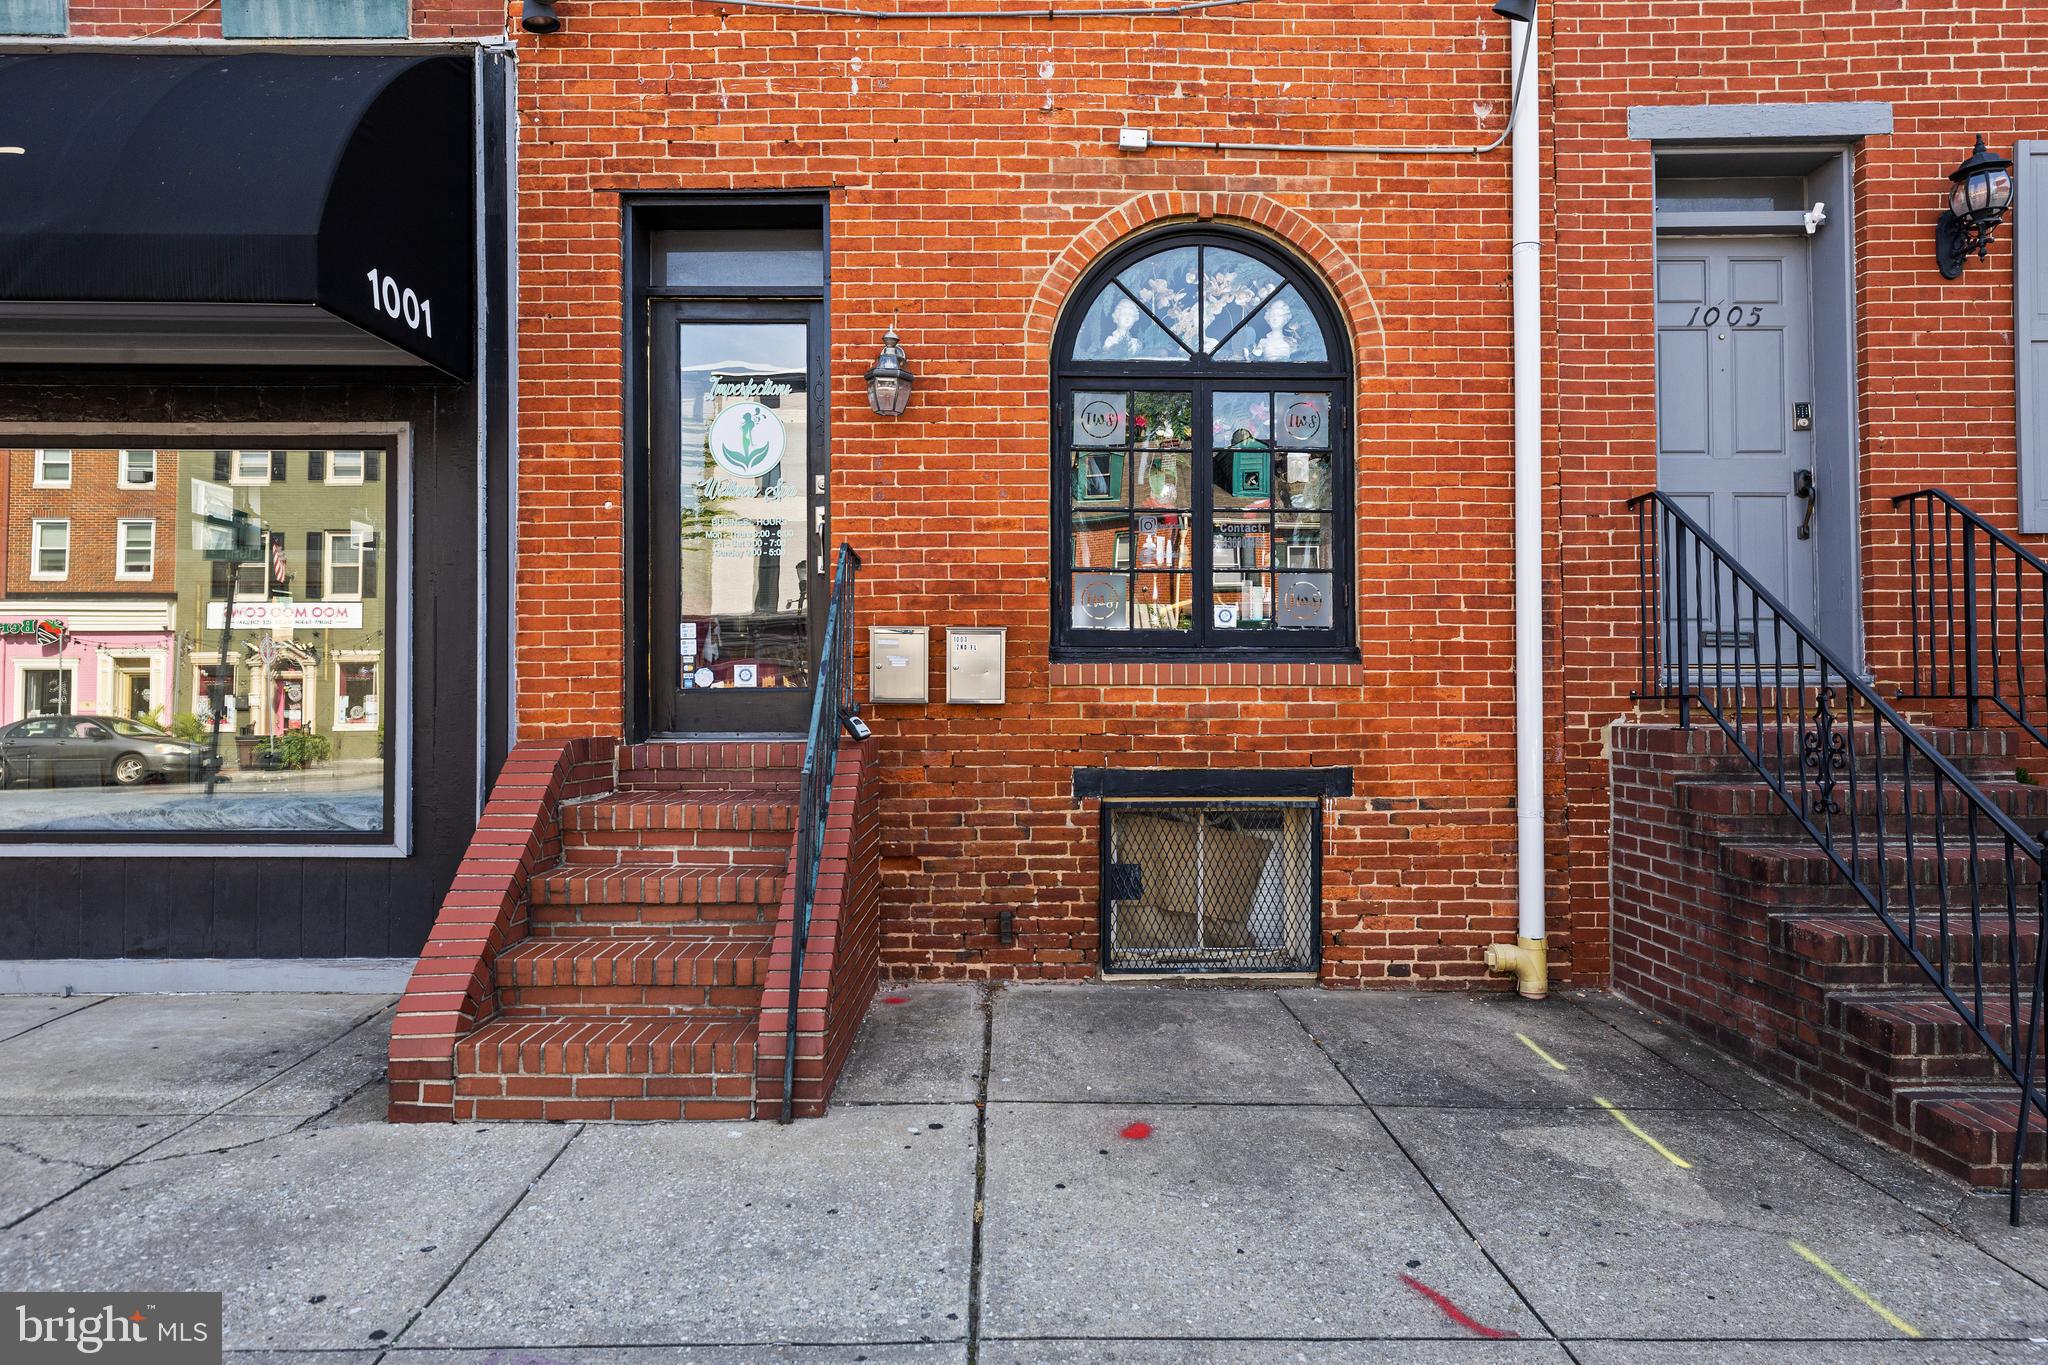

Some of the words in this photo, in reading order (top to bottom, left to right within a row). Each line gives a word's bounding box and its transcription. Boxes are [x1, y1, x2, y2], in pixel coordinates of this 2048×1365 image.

[366, 268, 432, 338] 1001
[1687, 305, 1763, 327] 1005
[704, 375, 793, 400] Imperfections
